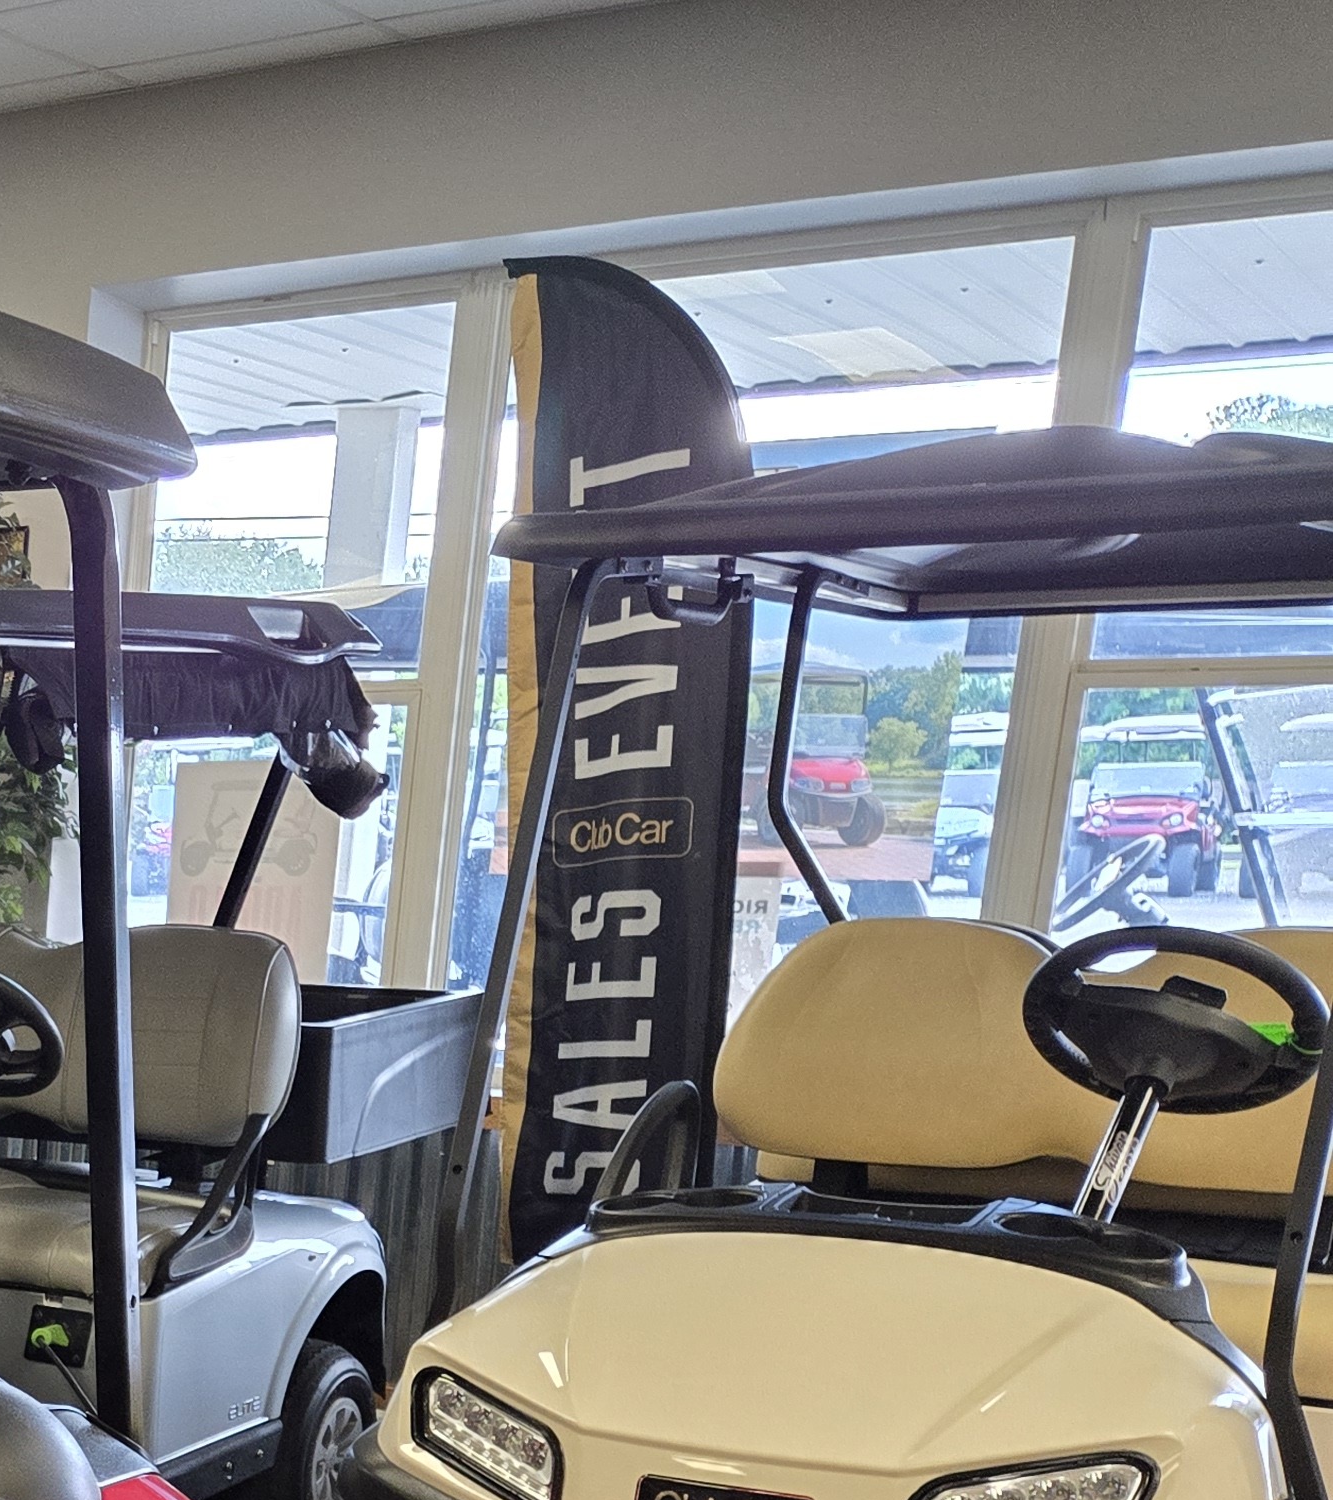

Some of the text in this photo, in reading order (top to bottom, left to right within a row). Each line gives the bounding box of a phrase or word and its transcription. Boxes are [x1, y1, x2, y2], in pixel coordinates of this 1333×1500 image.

[569, 448, 691, 780] EVET
[569, 812, 674, 853] Club Car
[543, 889, 662, 1196] SALES
